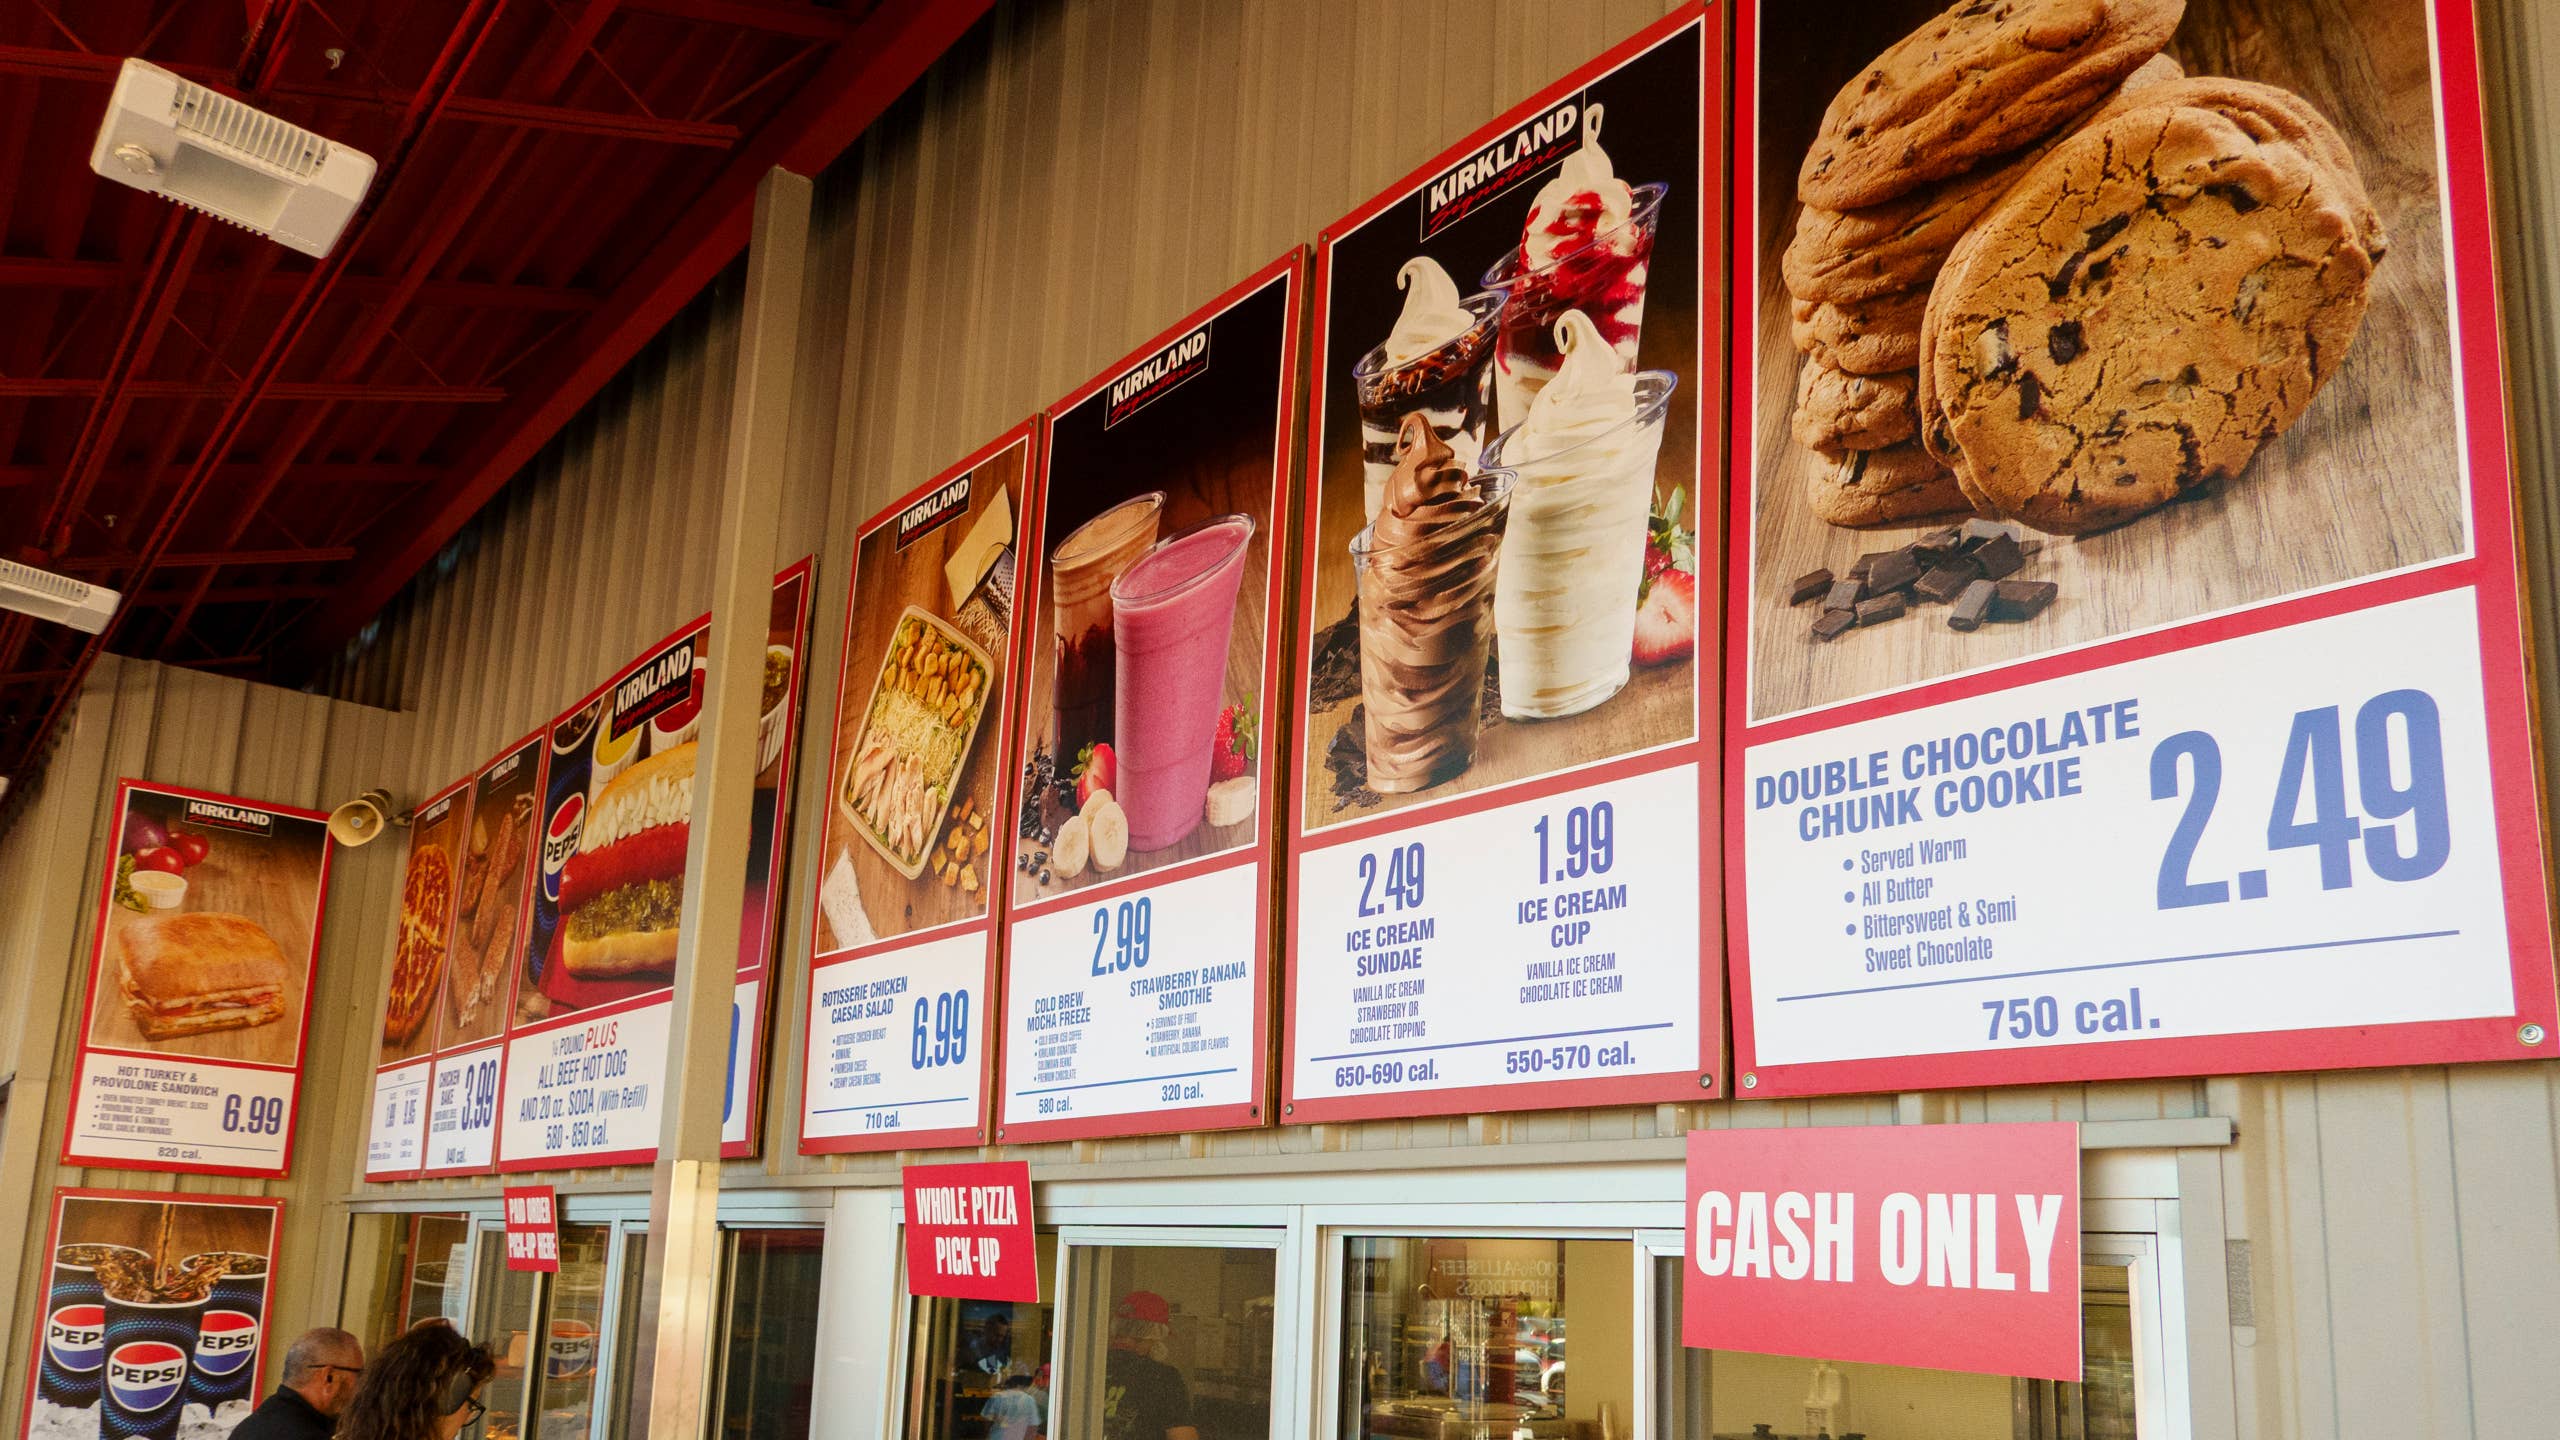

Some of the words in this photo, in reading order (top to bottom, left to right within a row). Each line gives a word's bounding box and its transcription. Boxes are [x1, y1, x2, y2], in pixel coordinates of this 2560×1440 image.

[1430, 105, 1578, 214] KIRKLAND
[1112, 332, 1206, 407] KIRKLAND
[901, 479, 969, 534] KIRKLAND
[616, 645, 691, 717] KIRKLAND
[1754, 750, 1889, 810] DOUBLE
[1902, 698, 2140, 782] CHOCOLATE
[189, 801, 270, 826] KIRKLAND
[1798, 779, 1923, 843] CHUNK
[1933, 756, 2082, 818] COOKIE
[2149, 688, 2451, 911] 2.49
[546, 822, 582, 862] PEPSI
[1533, 801, 1614, 885] 1.99
[1861, 843, 1914, 875] Served
[1918, 836, 1967, 868] Warm
[1358, 842, 1425, 918] 2.49
[1862, 880, 1884, 907] All
[1889, 873, 1934, 903] Butter
[1518, 900, 1548, 924] ICE
[1554, 884, 1627, 919] CREAM
[1863, 906, 1952, 940] Bittersweet
[1957, 902, 1974, 929] &
[1978, 896, 2017, 925] Semi
[1092, 896, 1151, 977] 2.99
[1346, 928, 1373, 953] ICE
[1376, 918, 1435, 949] CREAM
[1550, 920, 1591, 949] CUP
[1357, 947, 1422, 978] SUNDAE
[1526, 959, 1564, 981] VANILLA
[1566, 957, 1581, 976] ICE
[1583, 952, 1616, 973] CREAM
[1865, 943, 1913, 973] Sweet
[1917, 935, 1993, 968] Chocolate
[822, 983, 868, 1008] ROTISSERIE
[870, 976, 908, 998] CHICKEN
[1130, 969, 1199, 998] STRAWBERRY
[1202, 960, 1247, 985] BANANA
[1353, 983, 1383, 1004] VANILLA
[1385, 981, 1397, 1000] ICE
[1398, 978, 1425, 998] CREAM
[1519, 981, 1571, 1004] CHOCOLATE
[1572, 979, 1587, 997] ICE
[1590, 974, 1623, 995] CREAM
[832, 1004, 863, 1025] CAESAR
[865, 998, 894, 1018] SALAD
[1035, 996, 1056, 1014] COLD
[1058, 991, 1084, 1010] BREW
[1159, 986, 1213, 1011] SMOOTHIE
[1357, 1002, 1407, 1024] STRAWBERRY
[1408, 1000, 1419, 1017] OR
[1981, 995, 2060, 1040] 750
[2074, 987, 2162, 1035] cal.
[911, 989, 970, 1070] 6.99
[1027, 1013, 1057, 1032] MOCHA
[1059, 1007, 1091, 1027] FREEZE
[1350, 1024, 1391, 1045] CHOCOLATE
[1392, 1020, 1426, 1041] TOPPING
[559, 1033, 585, 1056] POUND
[585, 1021, 618, 1051] PLUS
[117, 1065, 140, 1078] HOT
[144, 1068, 187, 1082] TURKEY
[189, 1072, 198, 1083] &
[538, 1064, 554, 1089] ALL
[557, 1058, 581, 1086] BEEF
[581, 1054, 603, 1082] HOT
[604, 1049, 627, 1078] DOG
[1335, 1066, 1403, 1088] 650-690
[1408, 1059, 1439, 1082] cal.
[1506, 1044, 1591, 1075] 550-570
[1597, 1041, 1636, 1067] cal.
[92, 1076, 159, 1092] PROVOLONE
[161, 1083, 219, 1097] SANDWICH
[461, 1059, 497, 1131] 3.99
[520, 1097, 538, 1122] AND
[539, 1095, 551, 1120] 20
[553, 1099, 565, 1118] oz.
[568, 1087, 594, 1116] SODA
[597, 1088, 620, 1117] (With
[620, 1084, 648, 1112] Refill)
[1162, 1084, 1181, 1102] 320
[1184, 1081, 1204, 1100] cal.
[222, 1093, 283, 1136] 6.99
[865, 1112, 882, 1129] 710
[884, 1110, 900, 1128] cal.
[1038, 1098, 1054, 1114] 580
[1056, 1096, 1073, 1113] cal.
[546, 1124, 563, 1150] 580
[571, 1120, 590, 1147] 850
[592, 1118, 609, 1145] cal.
[157, 1147, 178, 1158] 820
[181, 1149, 202, 1160] cal.
[915, 1187, 968, 1226] WHOLE
[970, 1185, 1018, 1226] PIZZA
[935, 1237, 1001, 1277] PICK-UP
[1696, 1190, 1855, 1283] CASH
[1879, 1192, 2064, 1294] ONLY
[51, 1326, 104, 1345] PEP
[200, 1333, 255, 1350] EPSI
[111, 1364, 183, 1384] PEPSI
